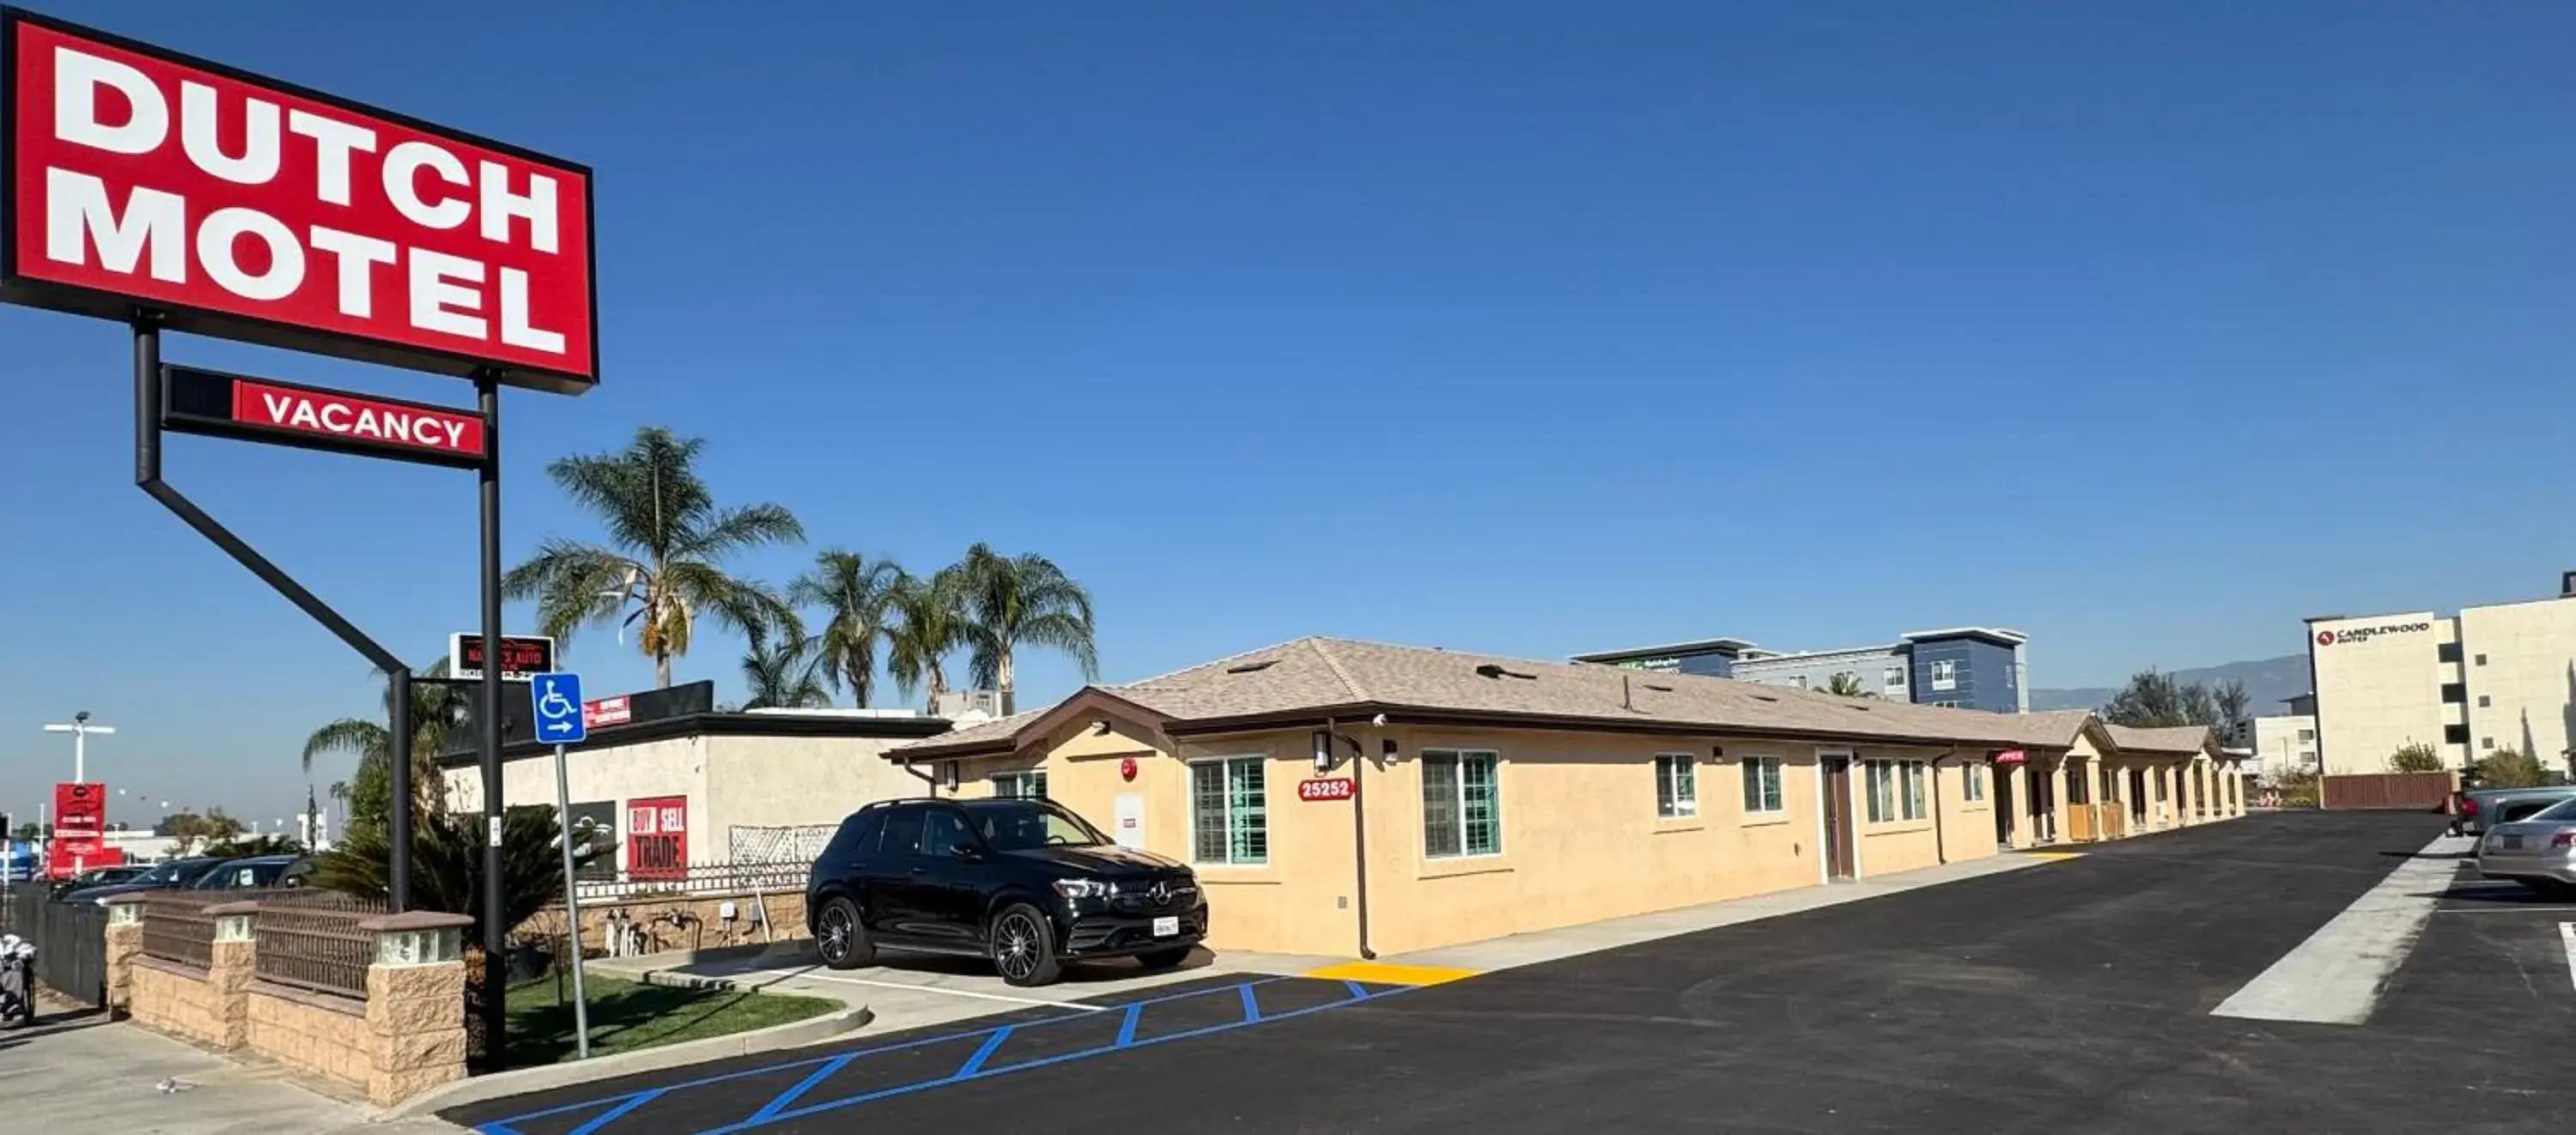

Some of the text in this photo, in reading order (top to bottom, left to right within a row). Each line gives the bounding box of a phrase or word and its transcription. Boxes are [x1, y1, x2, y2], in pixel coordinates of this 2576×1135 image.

[56, 47, 558, 253] DUTCH
[47, 167, 565, 354] MOTEL
[263, 392, 465, 447] VACANCY
[2336, 622, 2429, 637] CANDLEWOOD
[1303, 780, 1349, 798] 25252
[633, 807, 684, 833] BUY SELL
[635, 835, 680, 868] TRADE
